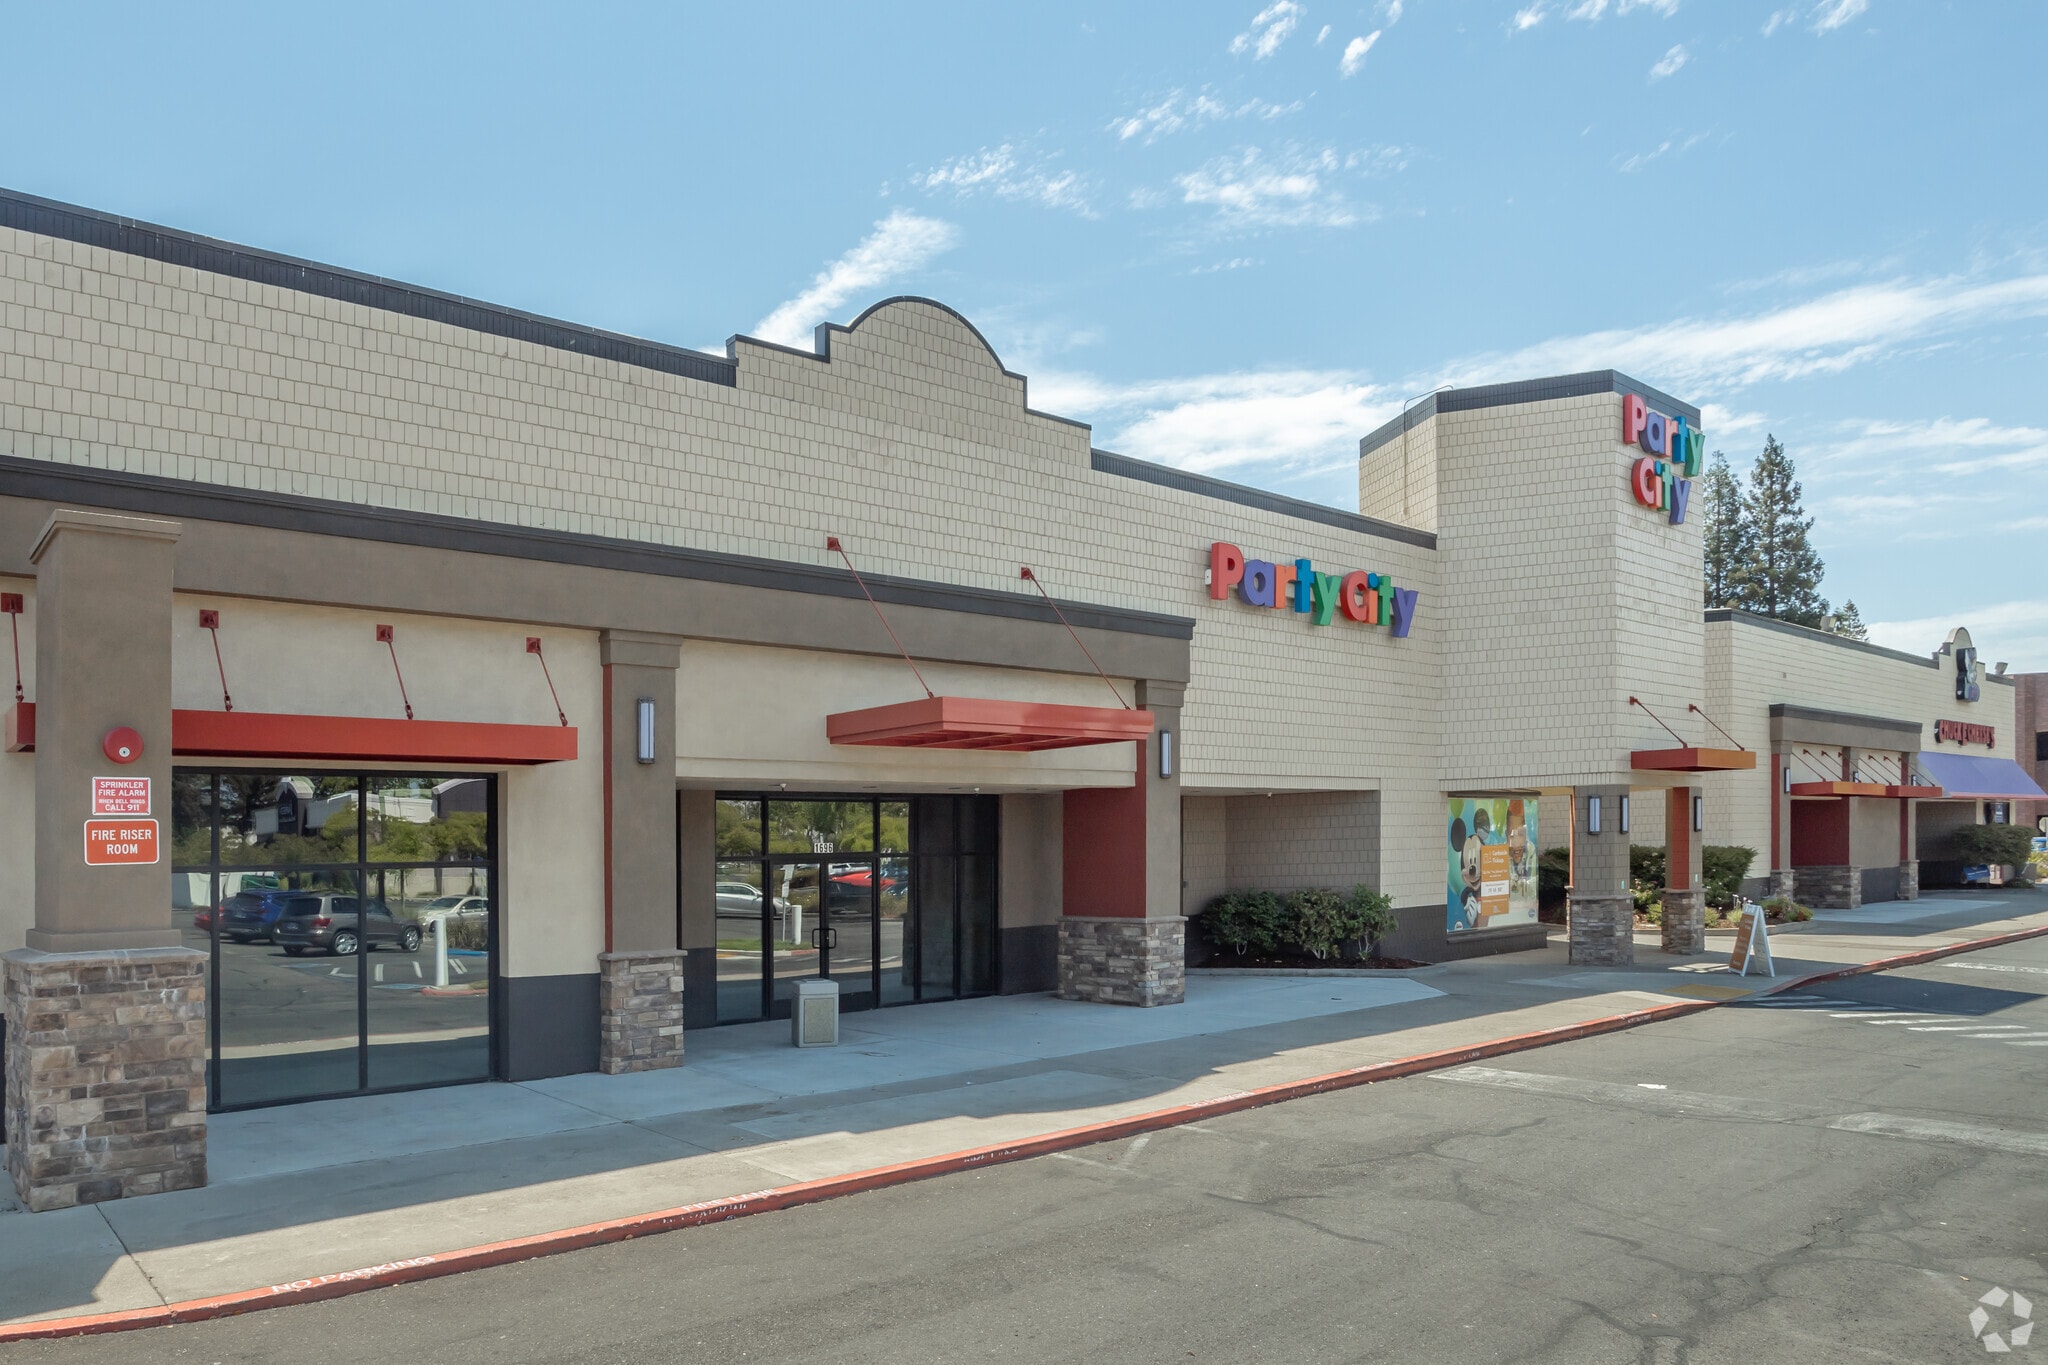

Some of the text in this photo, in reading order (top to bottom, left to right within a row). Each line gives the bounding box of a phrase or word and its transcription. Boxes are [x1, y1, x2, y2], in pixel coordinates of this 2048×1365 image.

[1623, 393, 1706, 477] Party
[1631, 456, 1692, 525] City
[1211, 541, 1419, 638] Party City
[100, 781, 144, 789] SPRINKLER
[98, 789, 146, 797] FIRE ALARM
[91, 829, 152, 841] FIRE RISER
[106, 843, 138, 855] ROOM
[815, 844, 833, 852] 1696
[271, 1256, 435, 1293] NO PARKING
